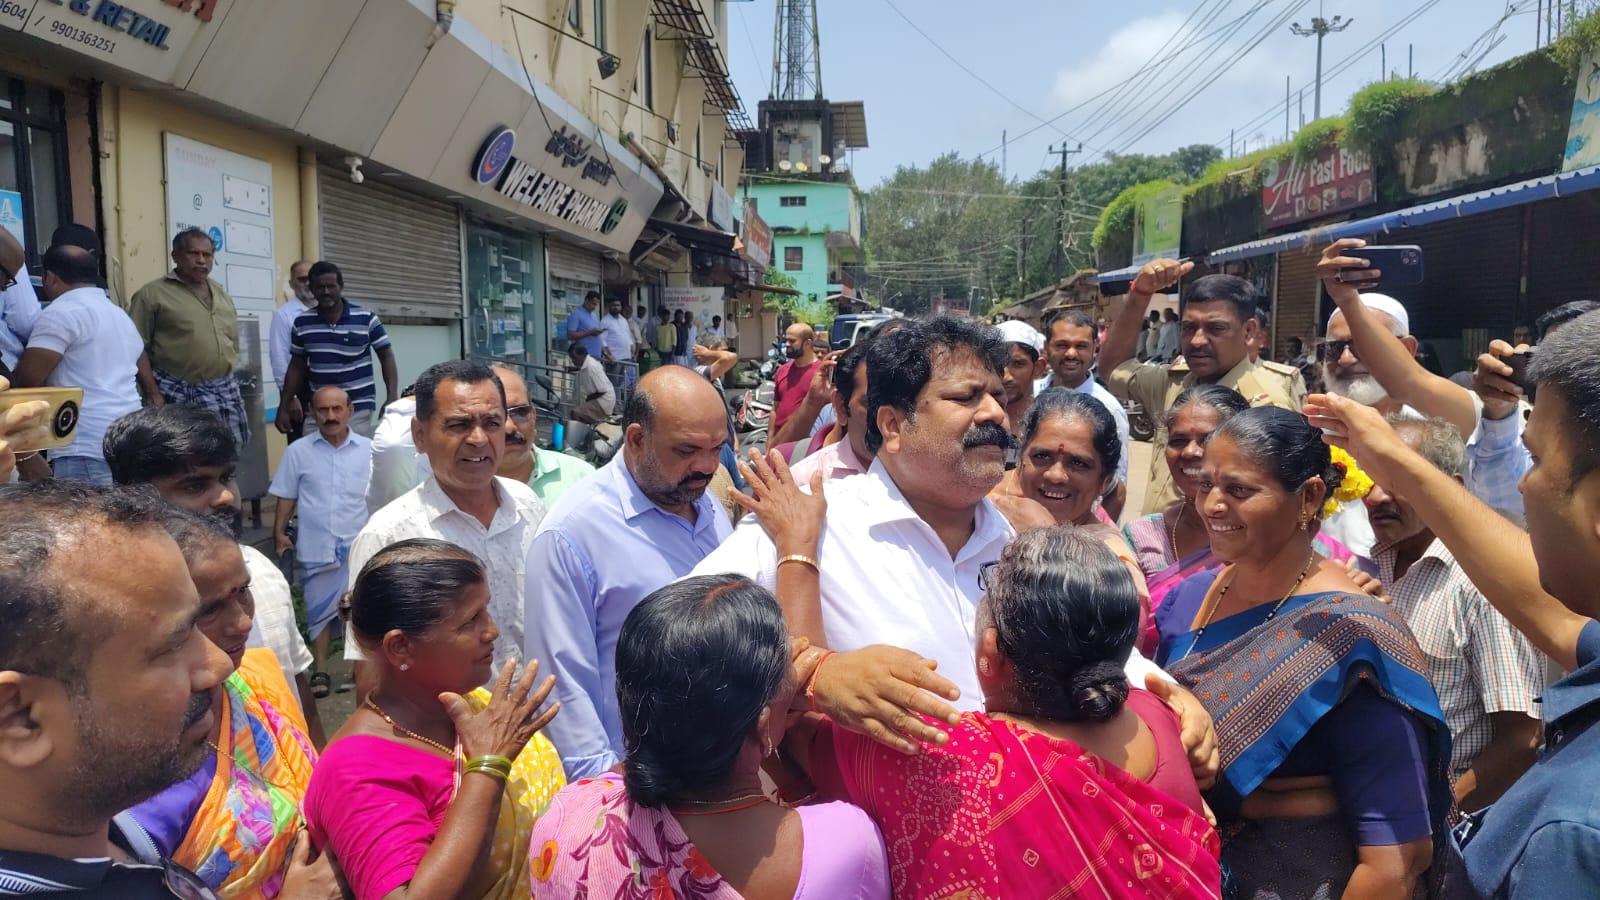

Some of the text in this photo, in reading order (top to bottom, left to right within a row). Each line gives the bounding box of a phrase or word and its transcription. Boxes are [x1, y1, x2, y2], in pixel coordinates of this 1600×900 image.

[50, 21, 116, 53] 9901363251
[93, 1, 170, 50] RETAIL
[1309, 153, 1335, 188] Fast
[499, 158, 575, 217] WELFARE
[563, 190, 612, 233] PHARMA
